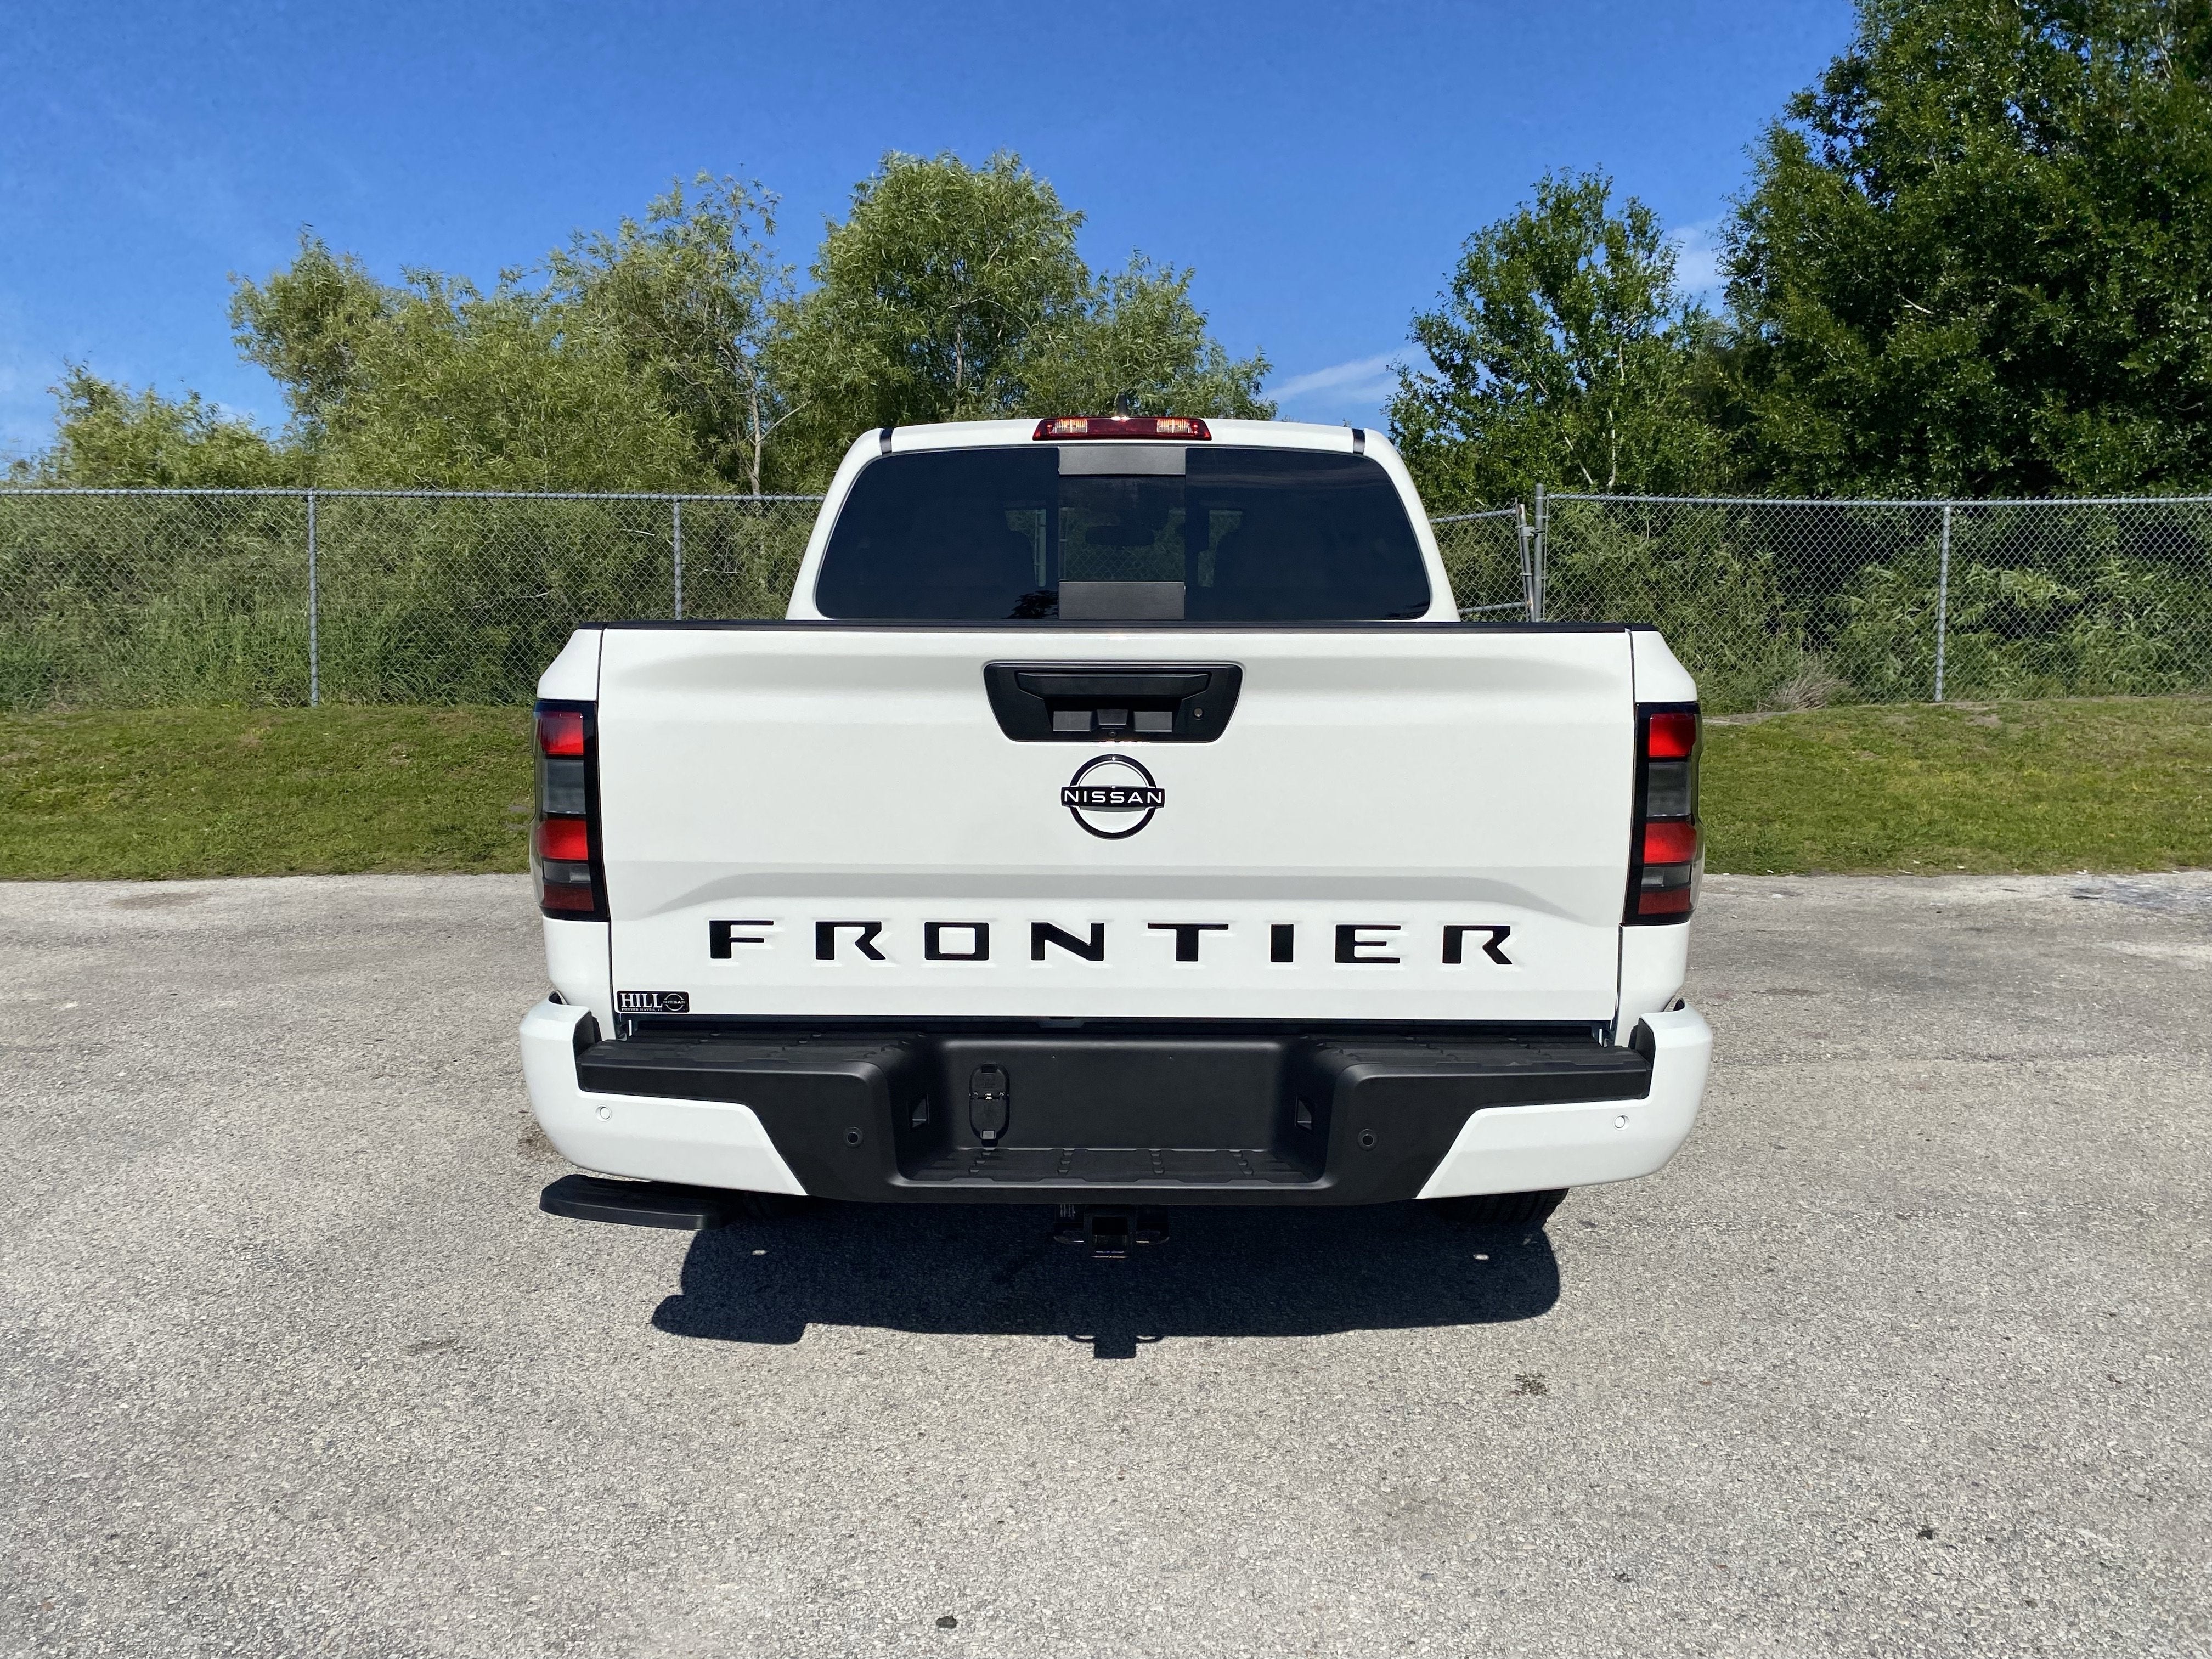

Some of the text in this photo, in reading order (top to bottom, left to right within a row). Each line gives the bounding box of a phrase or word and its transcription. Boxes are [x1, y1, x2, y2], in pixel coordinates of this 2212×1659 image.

[1064, 789, 1162, 804] NISSAN
[709, 919, 1515, 965] FRONTIER
[620, 992, 663, 1008] HILL
